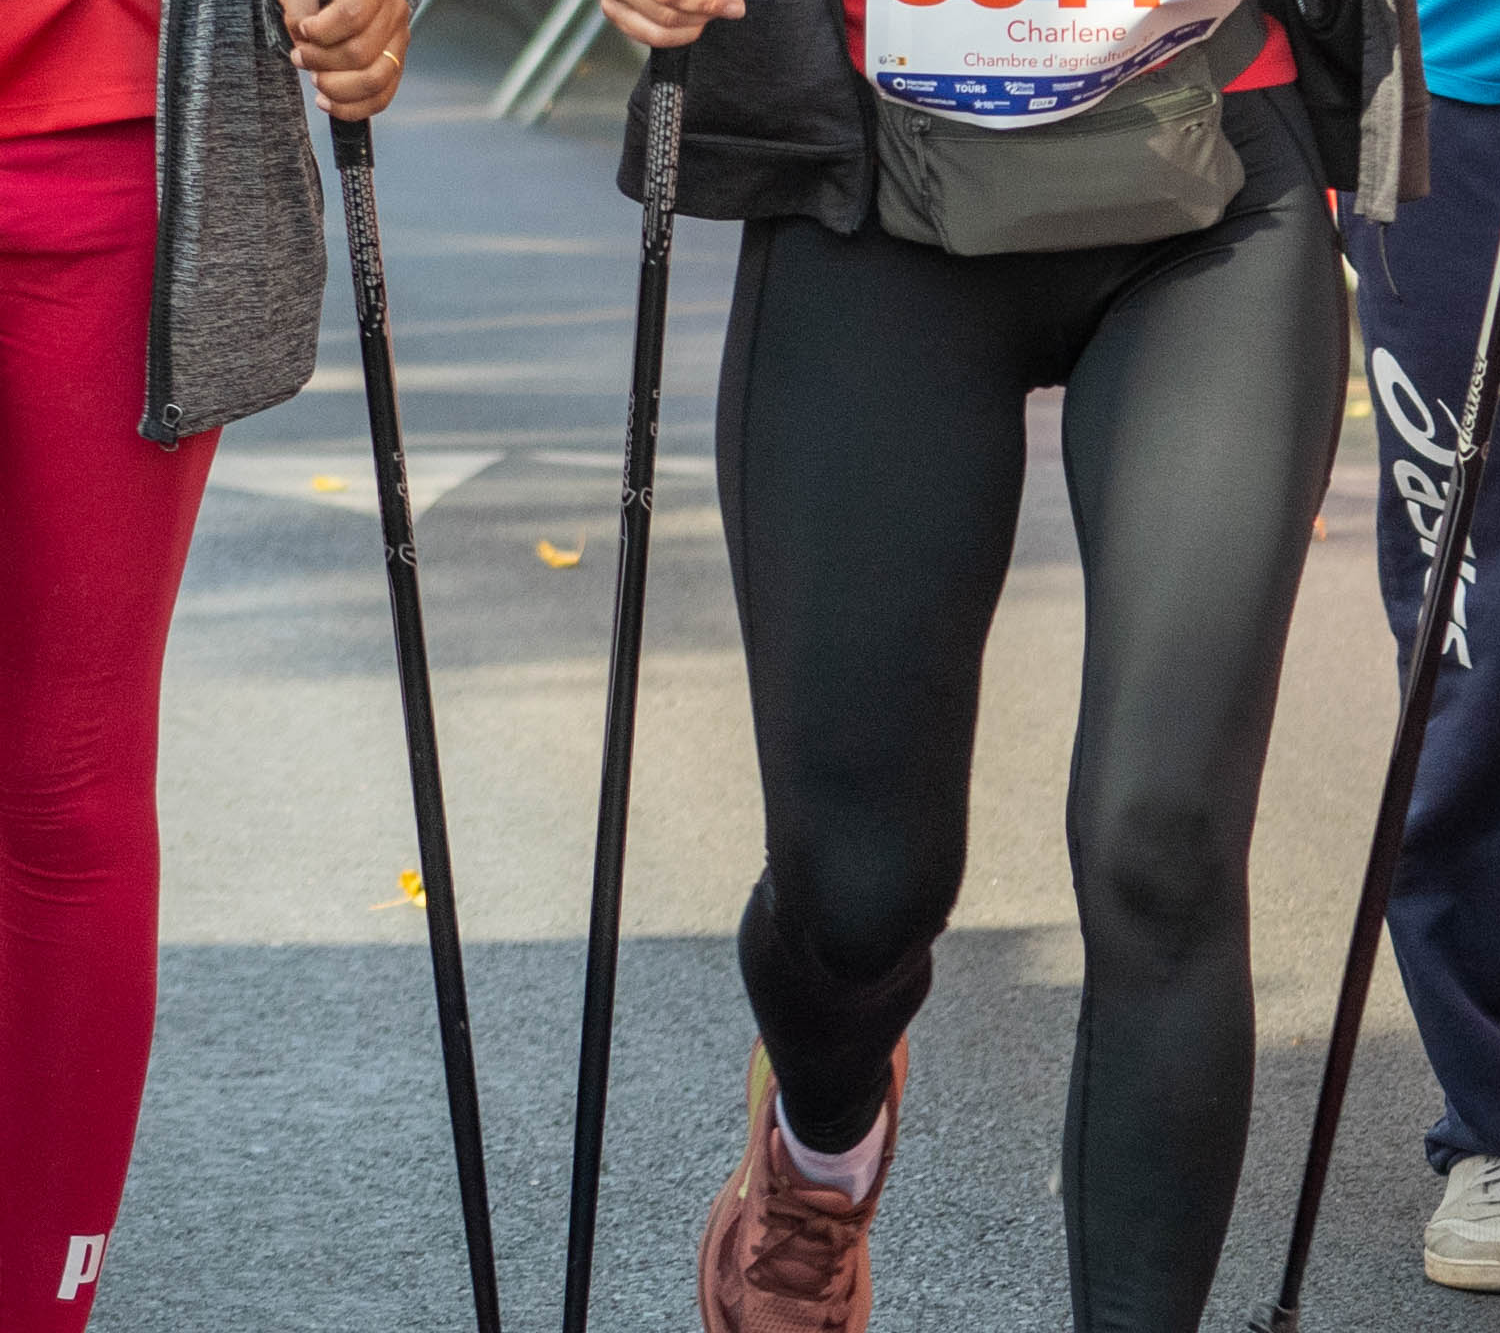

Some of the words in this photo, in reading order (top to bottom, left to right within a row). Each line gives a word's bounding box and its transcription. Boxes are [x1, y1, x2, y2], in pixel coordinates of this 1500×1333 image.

[1007, 19, 1128, 44] Charlene
[963, 52, 1038, 68] Chambre
[954, 83, 988, 94] TOURS
